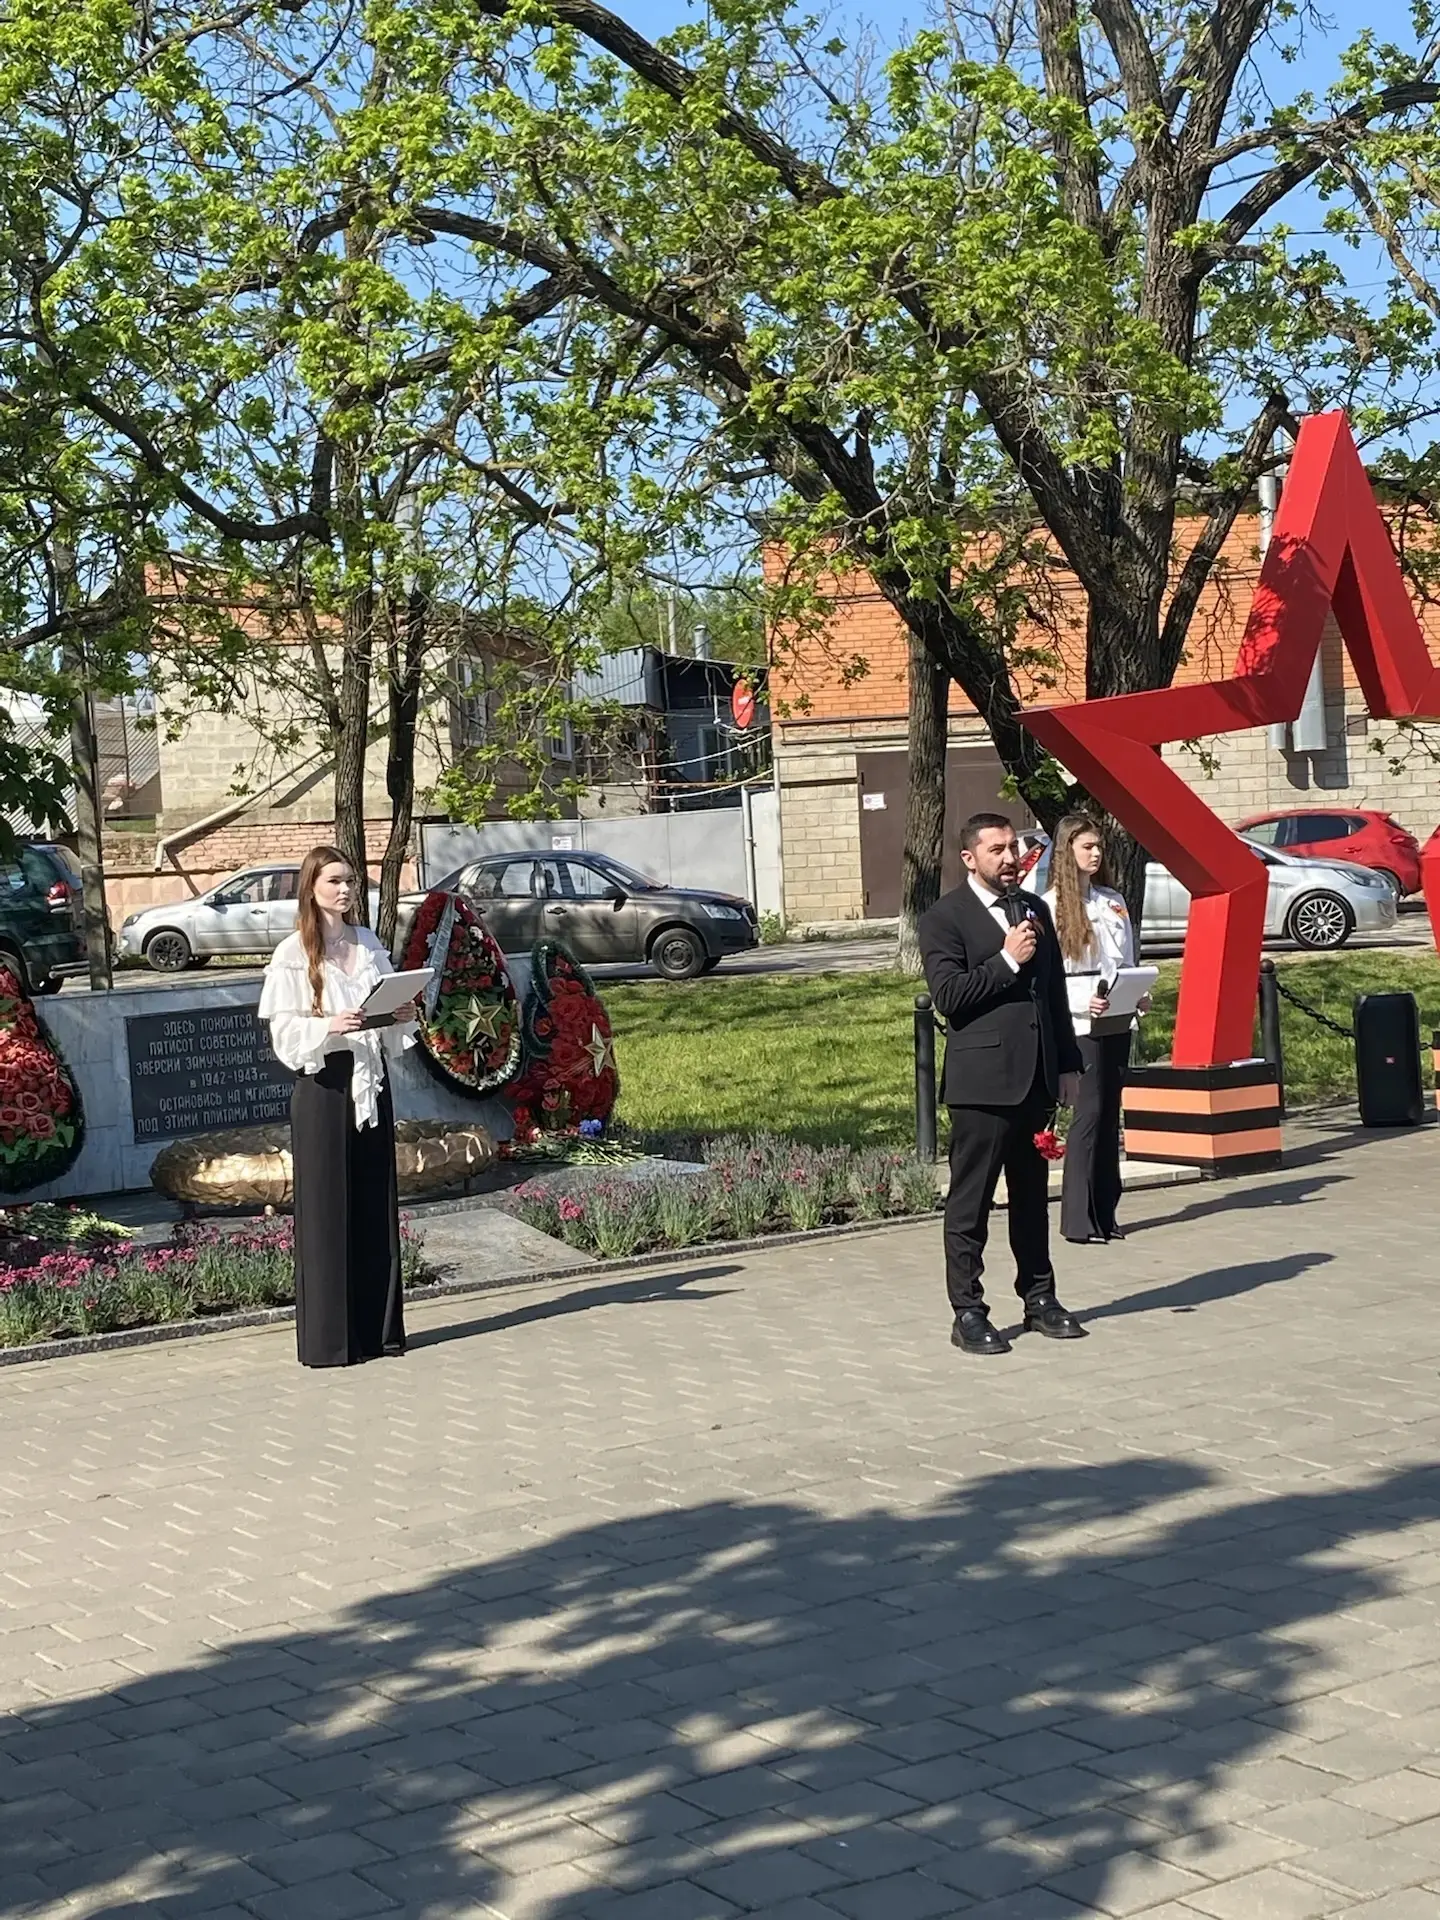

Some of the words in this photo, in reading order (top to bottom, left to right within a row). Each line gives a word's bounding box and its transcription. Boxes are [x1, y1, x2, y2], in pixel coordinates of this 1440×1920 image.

[163, 1020, 195, 1036] ЗДЕСЬ
[201, 1013, 252, 1032] ПОКОИТСЯ
[149, 1039, 193, 1056] ПЯТИСОТ
[200, 1031, 256, 1050] СОВЕТСКИХ
[136, 1058, 180, 1076] ЗВЕРСКИ
[185, 1049, 252, 1070] ЗАМУЧЕННЫХ
[160, 1092, 222, 1111] ОСТАНОВИСЬ
[227, 1089, 240, 1104] НА
[245, 1083, 295, 1102] МГНОВЕНИ
[137, 1117, 158, 1133] ПОД
[164, 1111, 198, 1130] ЭТИМИ
[203, 1106, 248, 1125] ПЛИТАМИ
[252, 1101, 287, 1119] СТОНЕТ
